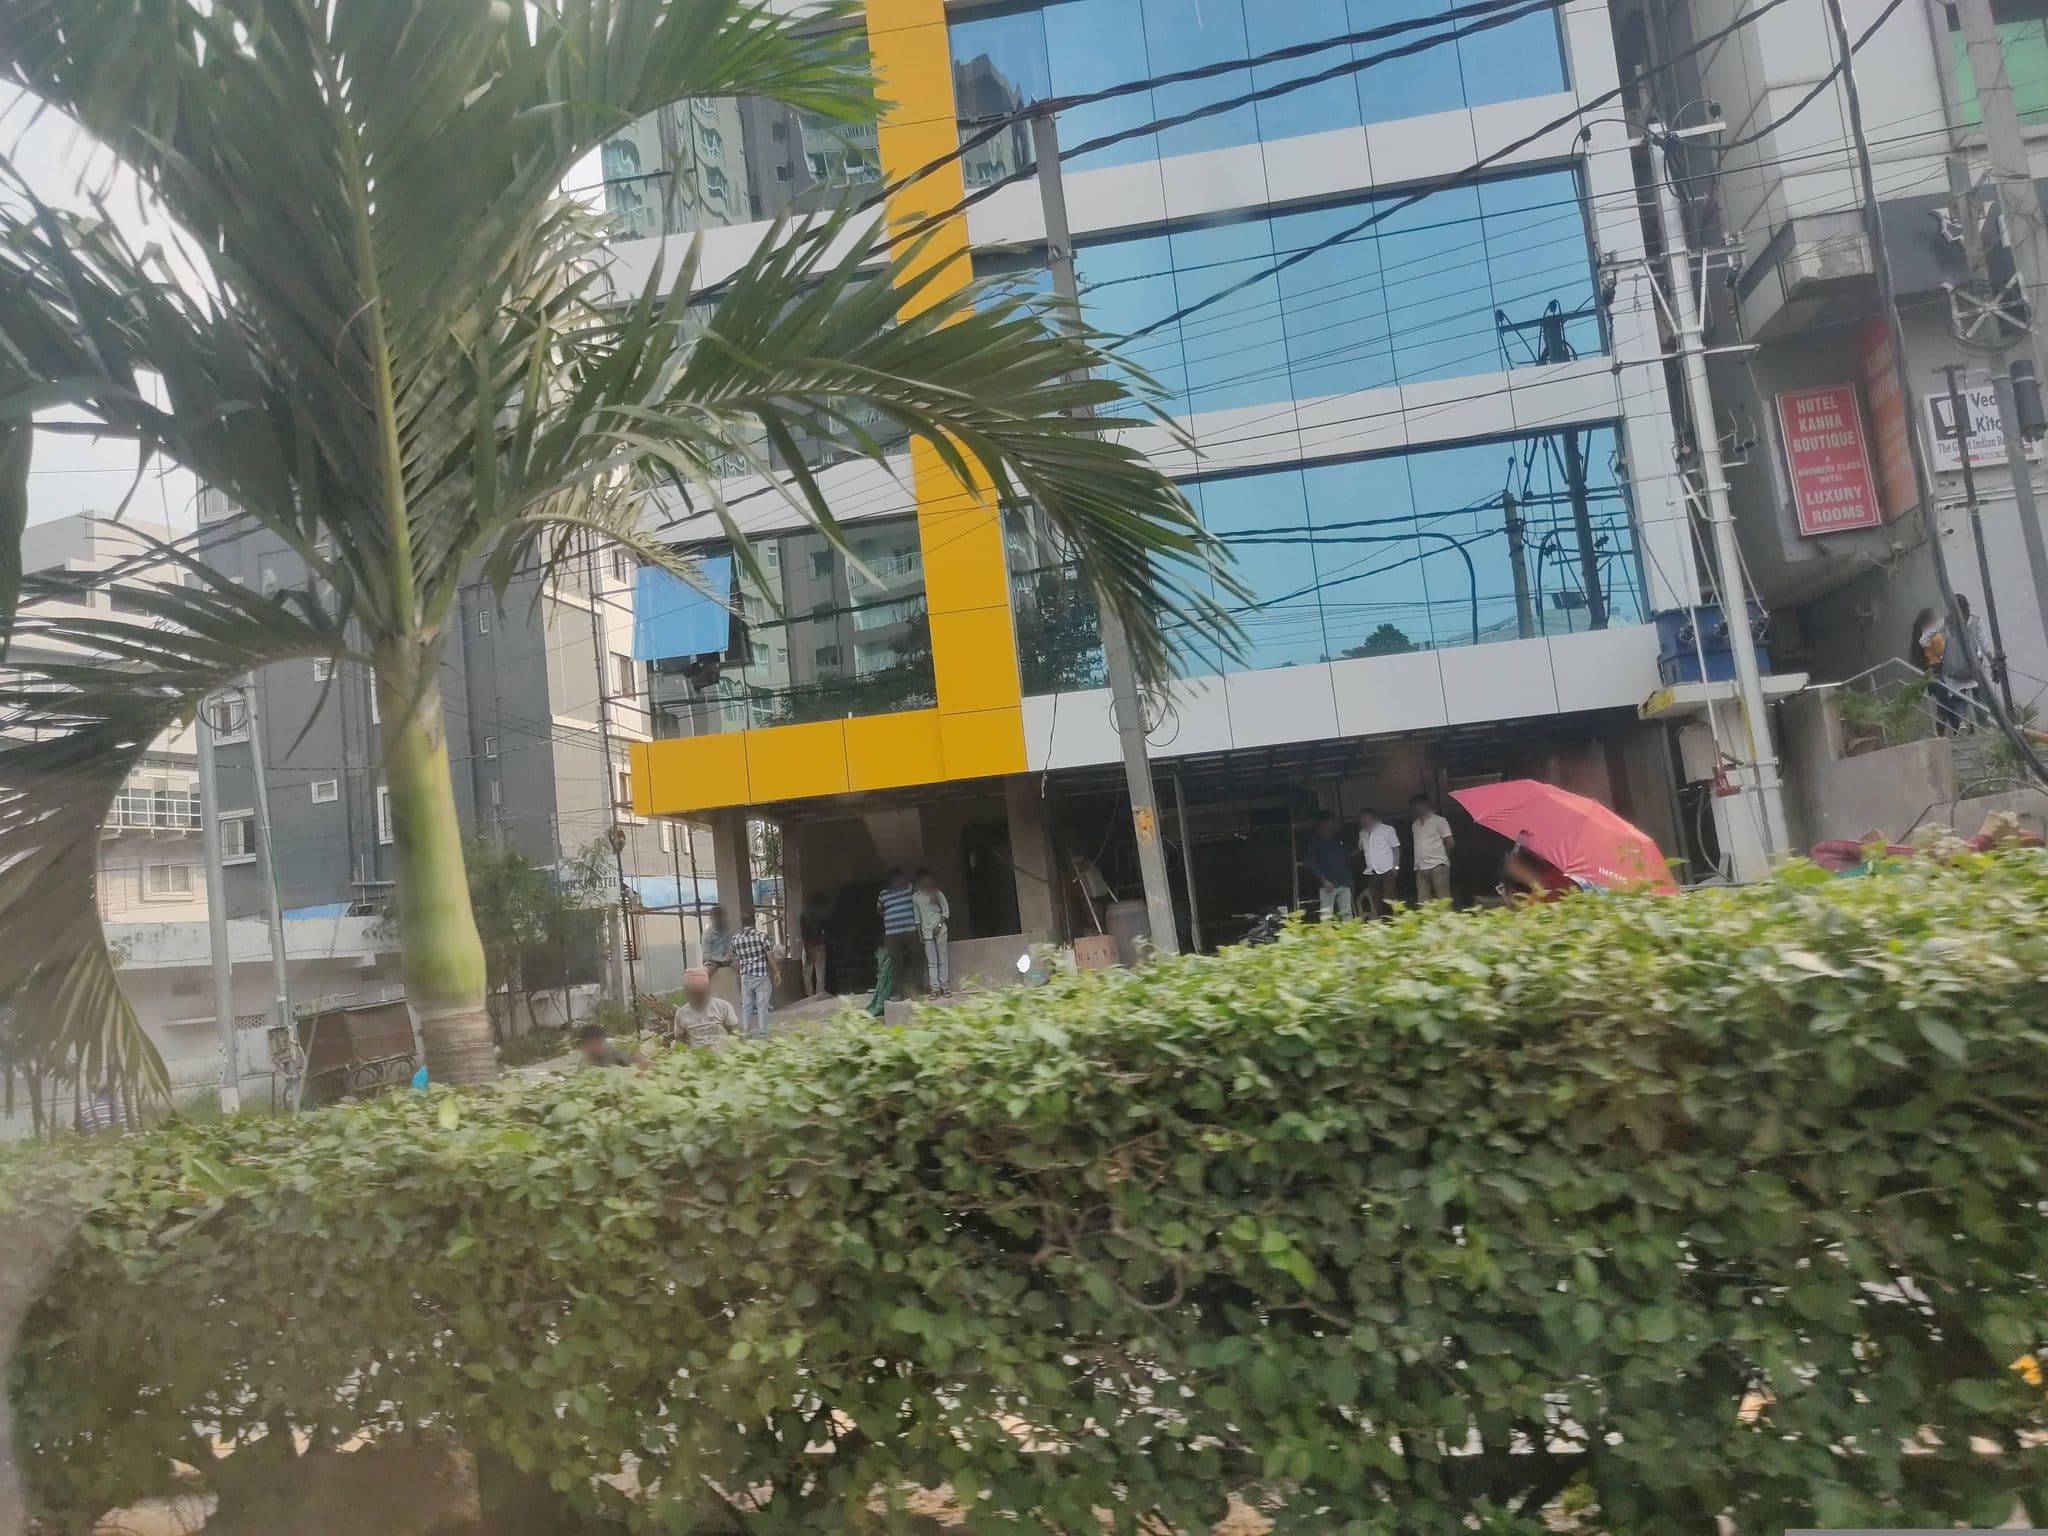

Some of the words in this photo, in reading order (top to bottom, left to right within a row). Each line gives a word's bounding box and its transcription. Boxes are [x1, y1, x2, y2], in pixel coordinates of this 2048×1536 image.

[1797, 396, 1839, 414] HOTEL
[1799, 414, 1844, 433] KANHA
[1792, 432, 1856, 452] BOUTIQUE
[1806, 486, 1862, 505] LUXURY
[1812, 505, 1865, 524] ROOMS
